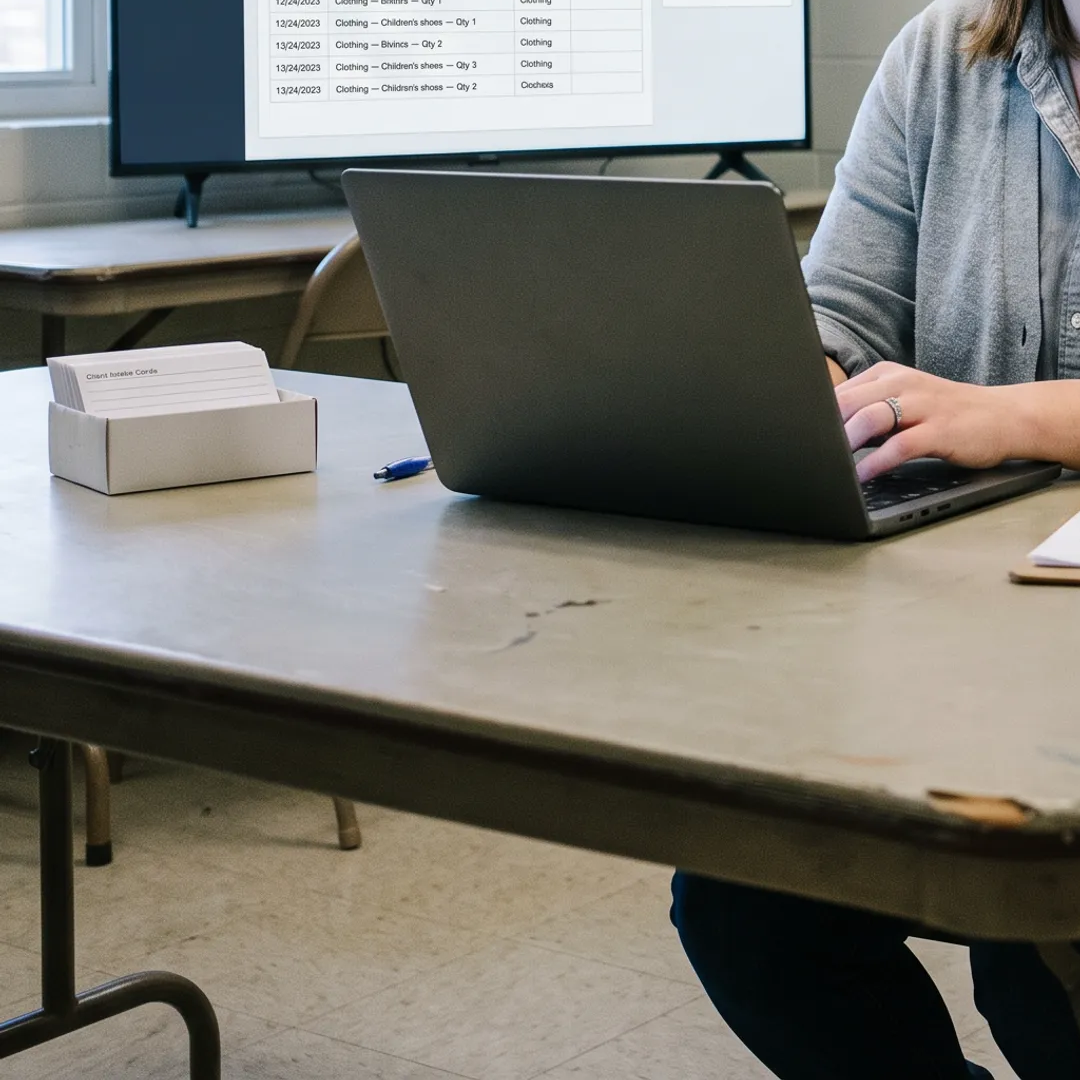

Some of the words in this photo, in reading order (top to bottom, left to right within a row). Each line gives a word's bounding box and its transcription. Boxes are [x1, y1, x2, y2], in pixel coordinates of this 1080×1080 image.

[335, 19, 368, 28] Clothing
[381, 18, 418, 26] Children's
[420, 18, 443, 26] shoes
[520, 17, 551, 26] Clothing
[335, 41, 368, 50] Clothing
[520, 38, 552, 47] Clothing
[336, 63, 369, 72] Clothing
[456, 61, 470, 71] Qty
[520, 59, 553, 69] Clothing
[336, 85, 369, 94] Clothing
[456, 83, 470, 93] Qty
